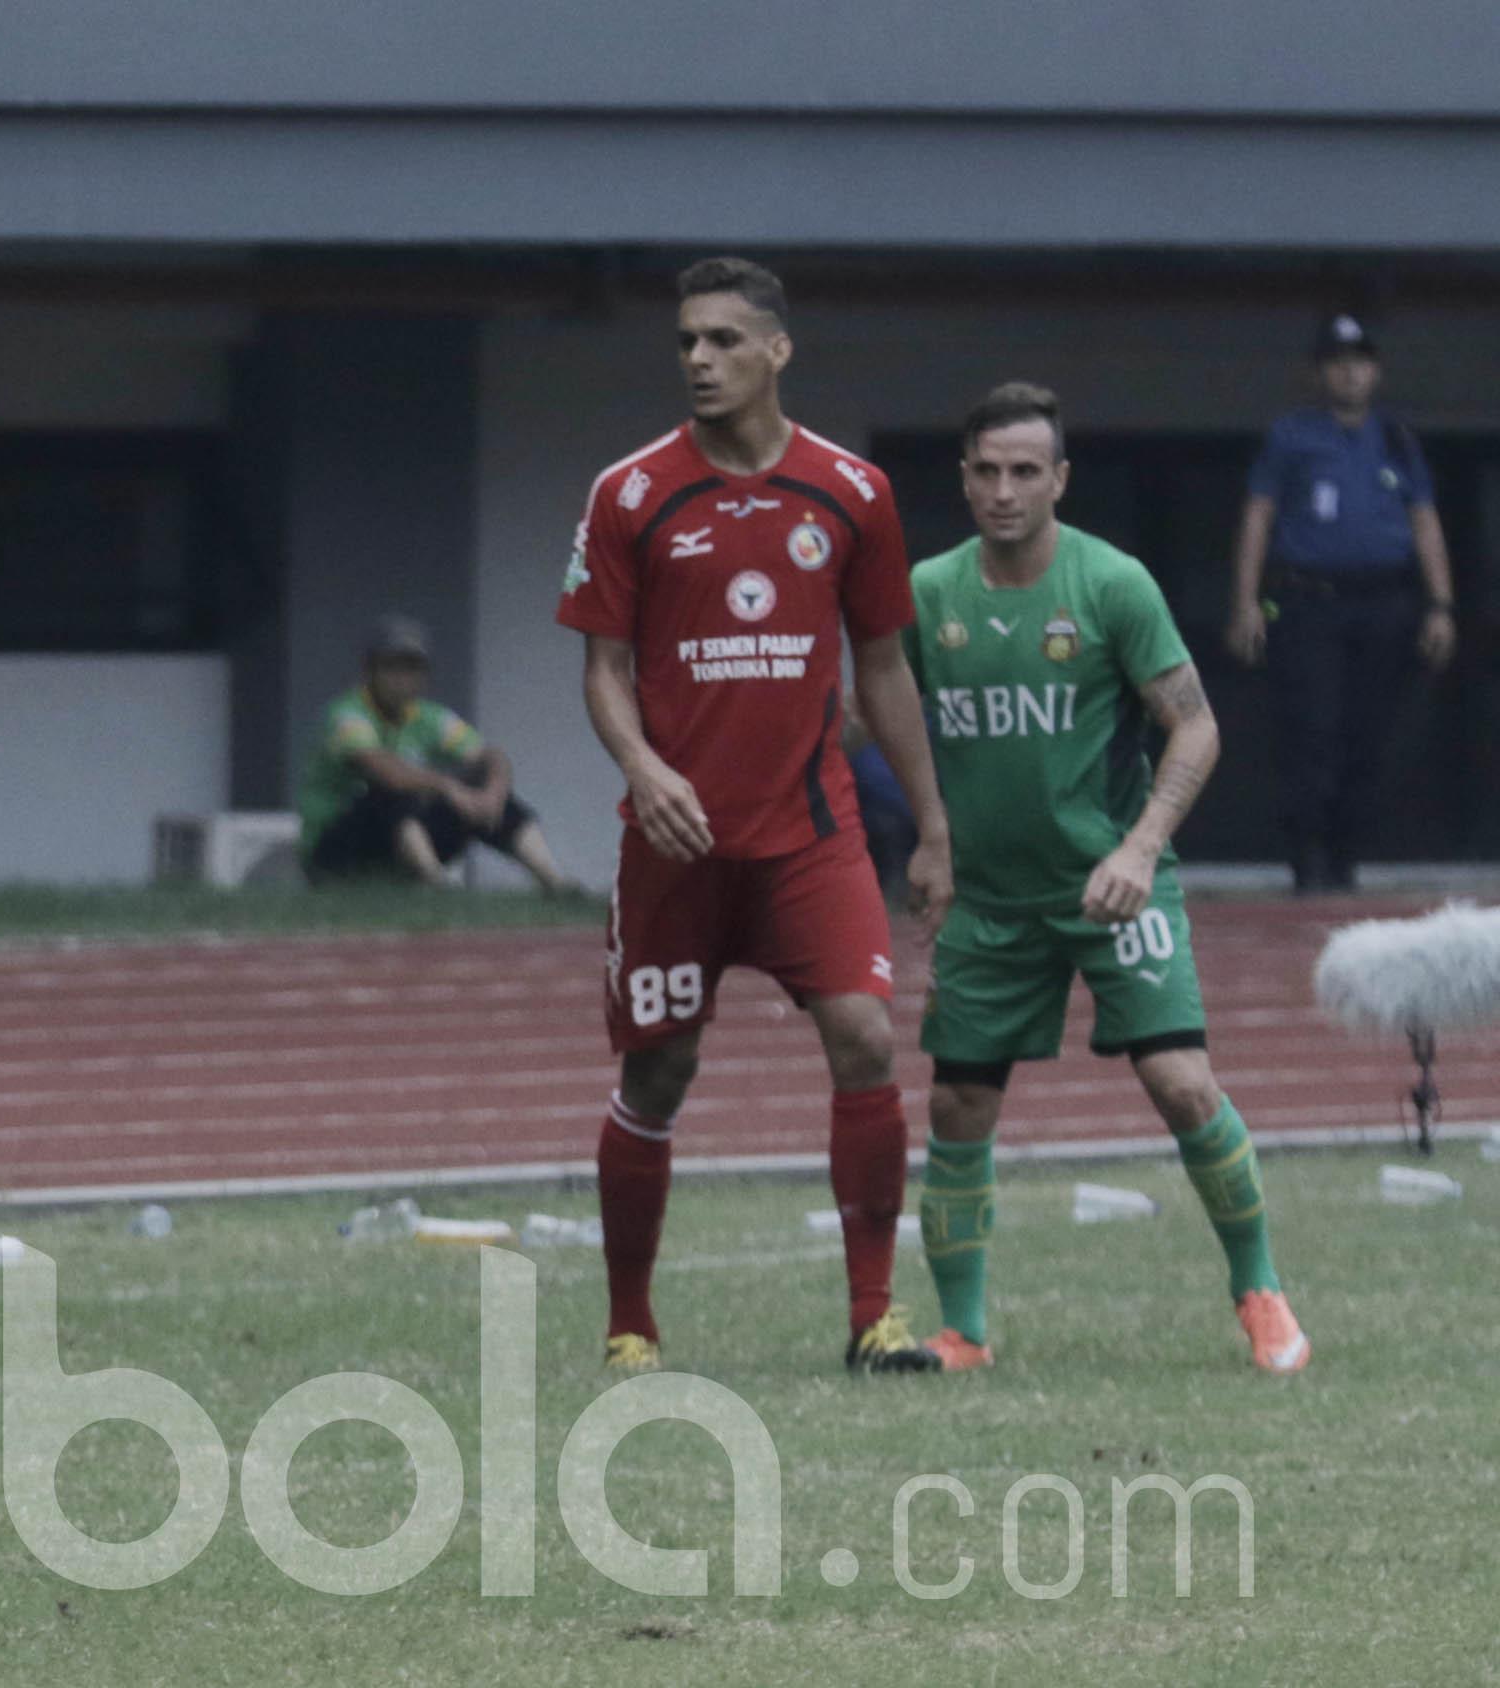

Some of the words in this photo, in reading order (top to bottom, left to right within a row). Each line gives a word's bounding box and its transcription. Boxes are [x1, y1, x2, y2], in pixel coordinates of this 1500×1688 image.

[983, 683, 1077, 737] BNI
[1108, 907, 1175, 967] 80
[628, 962, 704, 1027] 89
